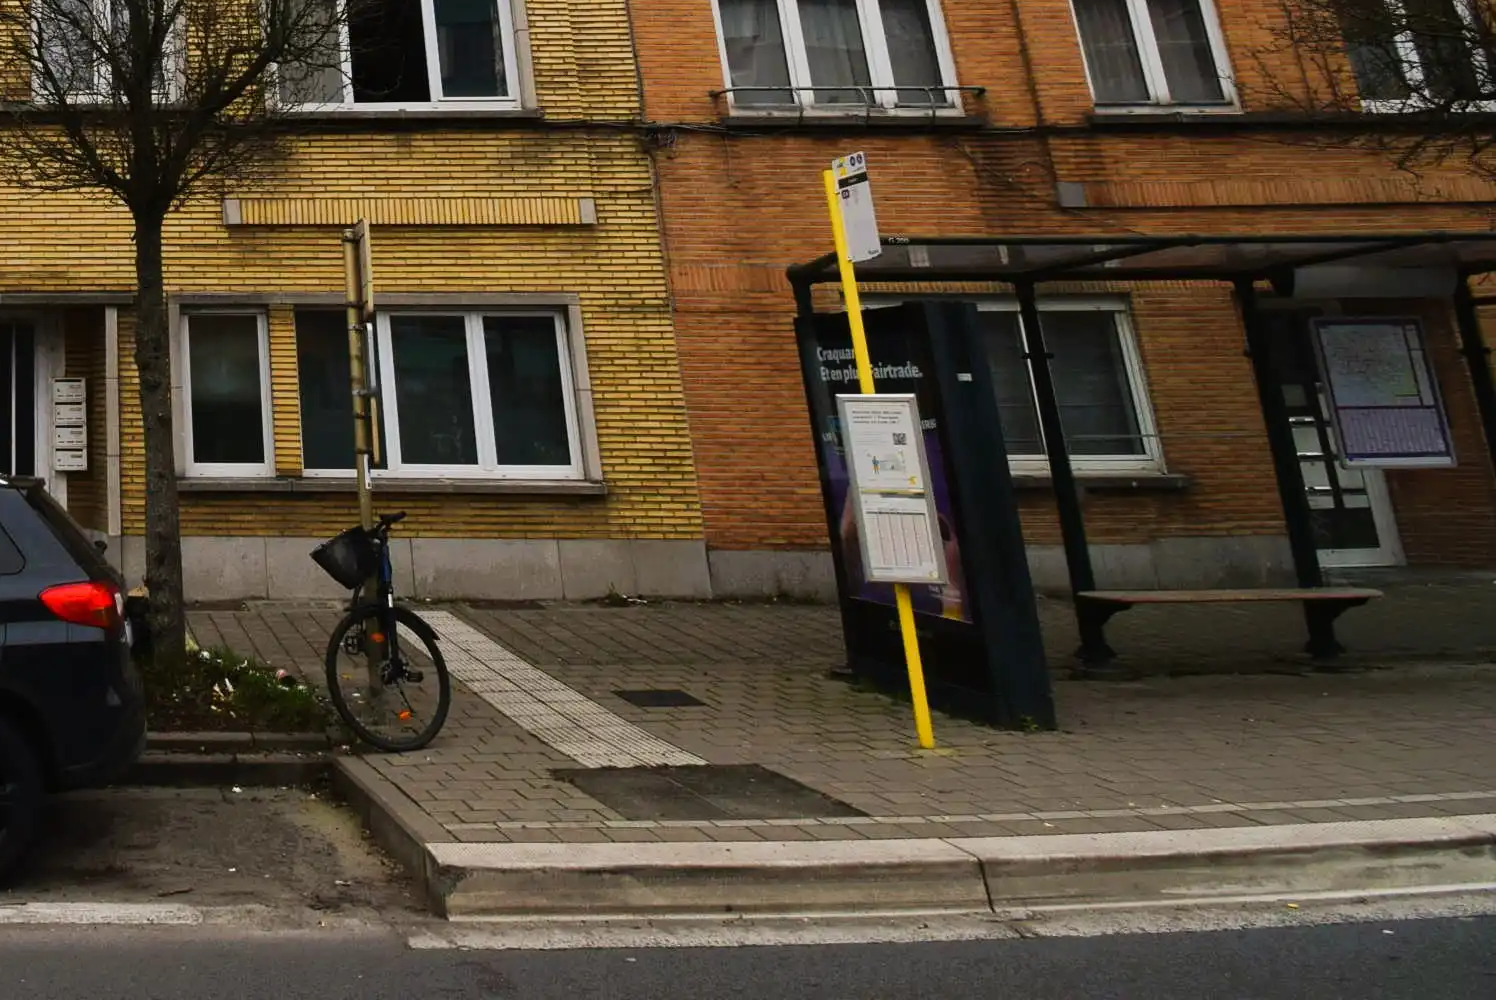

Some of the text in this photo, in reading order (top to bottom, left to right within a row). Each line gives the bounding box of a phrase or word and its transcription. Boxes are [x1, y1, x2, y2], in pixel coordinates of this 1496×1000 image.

[820, 366, 830, 381] Et
[831, 369, 843, 380] en
[870, 361, 924, 379] airtrade.
